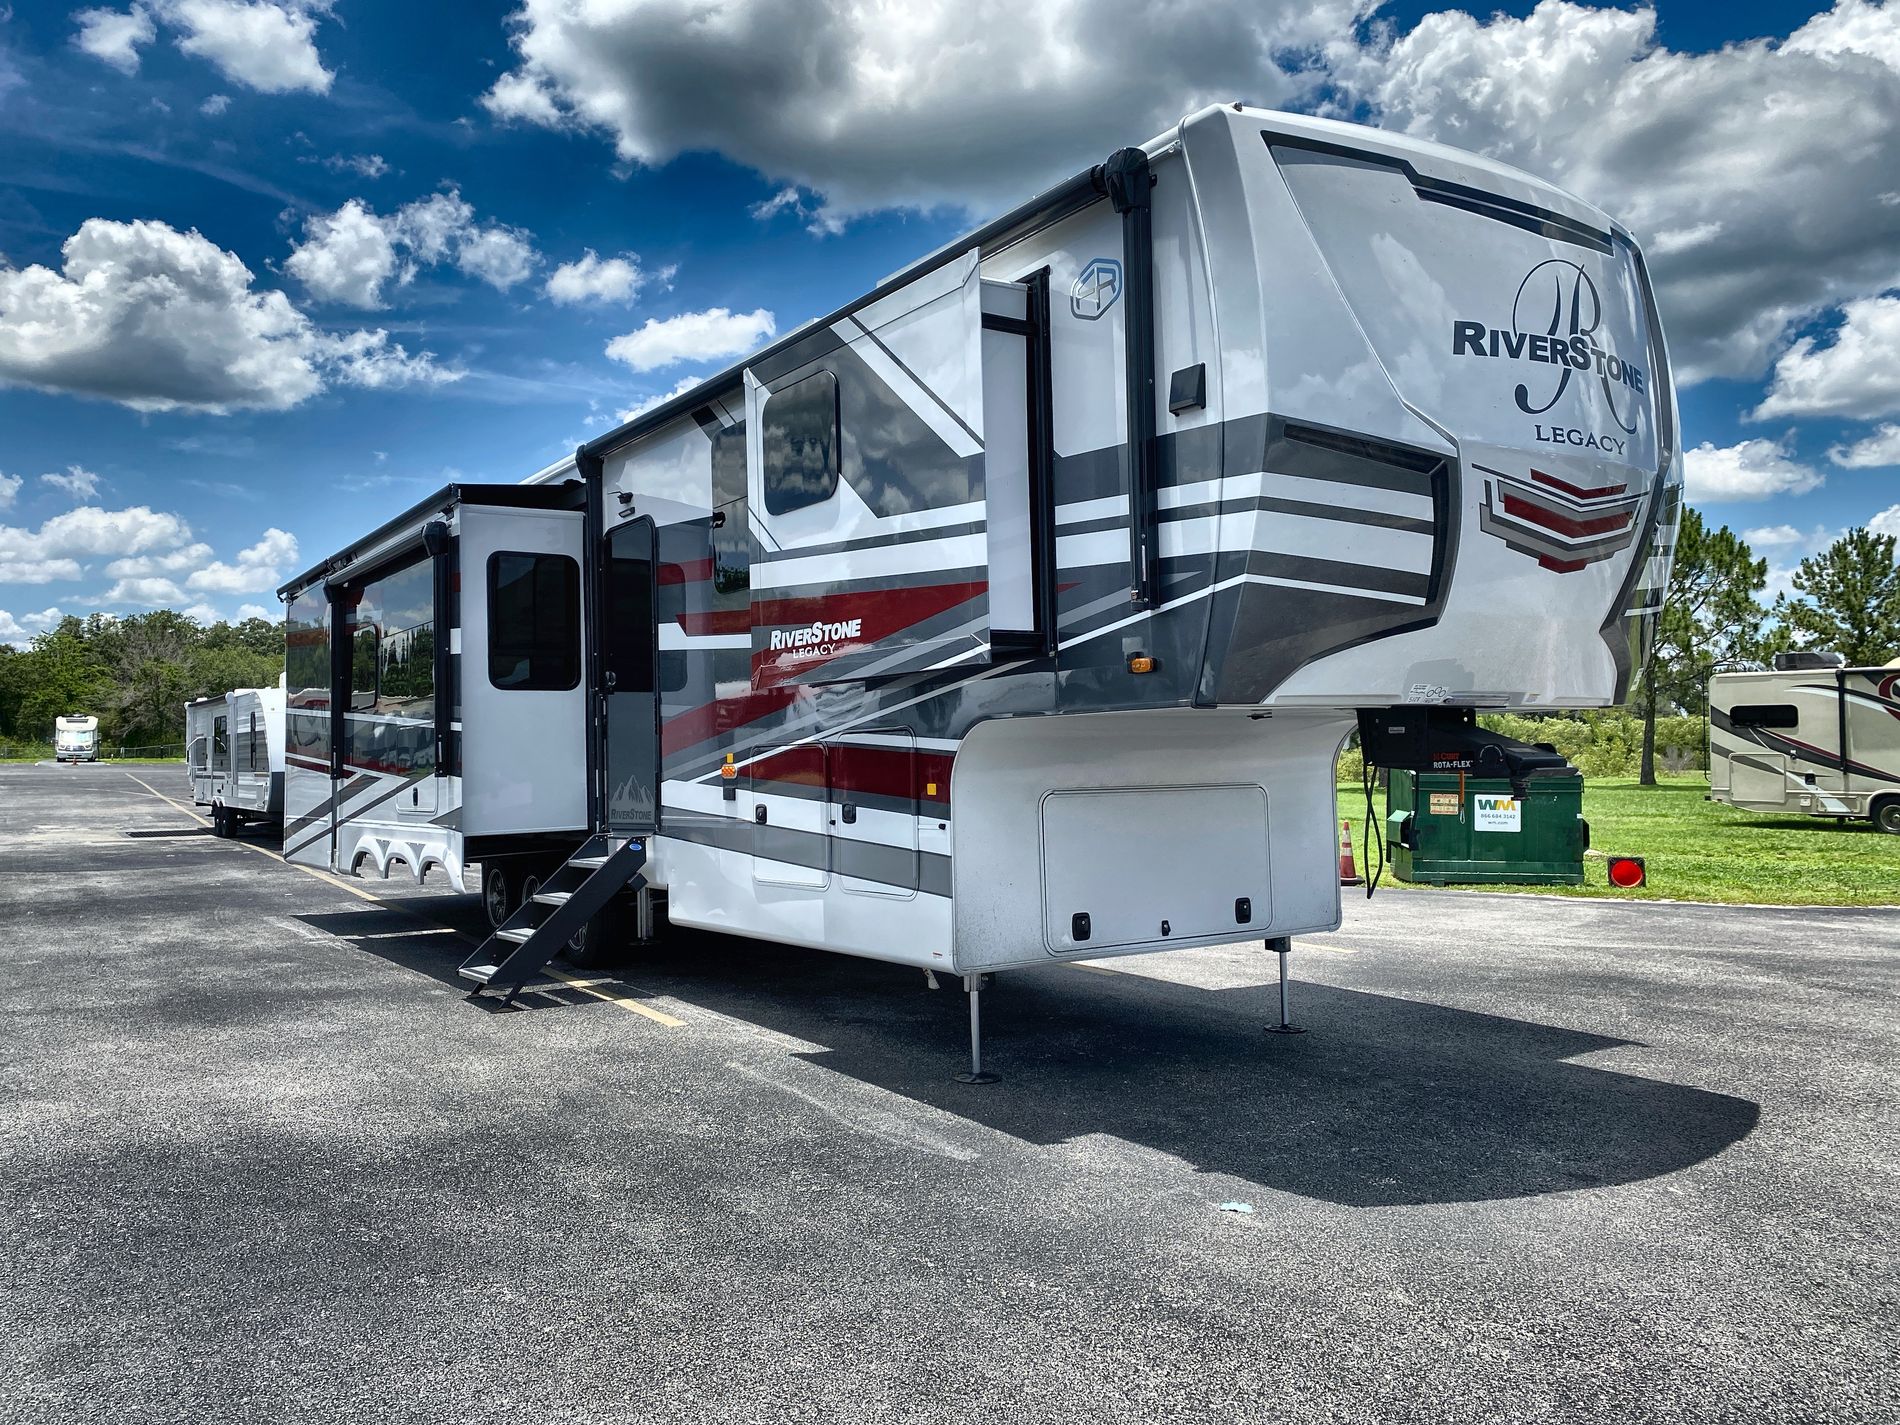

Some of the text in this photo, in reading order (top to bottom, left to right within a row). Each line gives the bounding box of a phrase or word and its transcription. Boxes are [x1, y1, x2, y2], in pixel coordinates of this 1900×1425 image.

[1453, 320, 1644, 395] RIVERSTONE
[1535, 424, 1627, 455] LEGACY
[770, 618, 862, 650] RIVERSTONE
[792, 643, 836, 659] LEGACY
[611, 808, 652, 820] RIVERSTONE
[1477, 799, 1516, 811] WM
